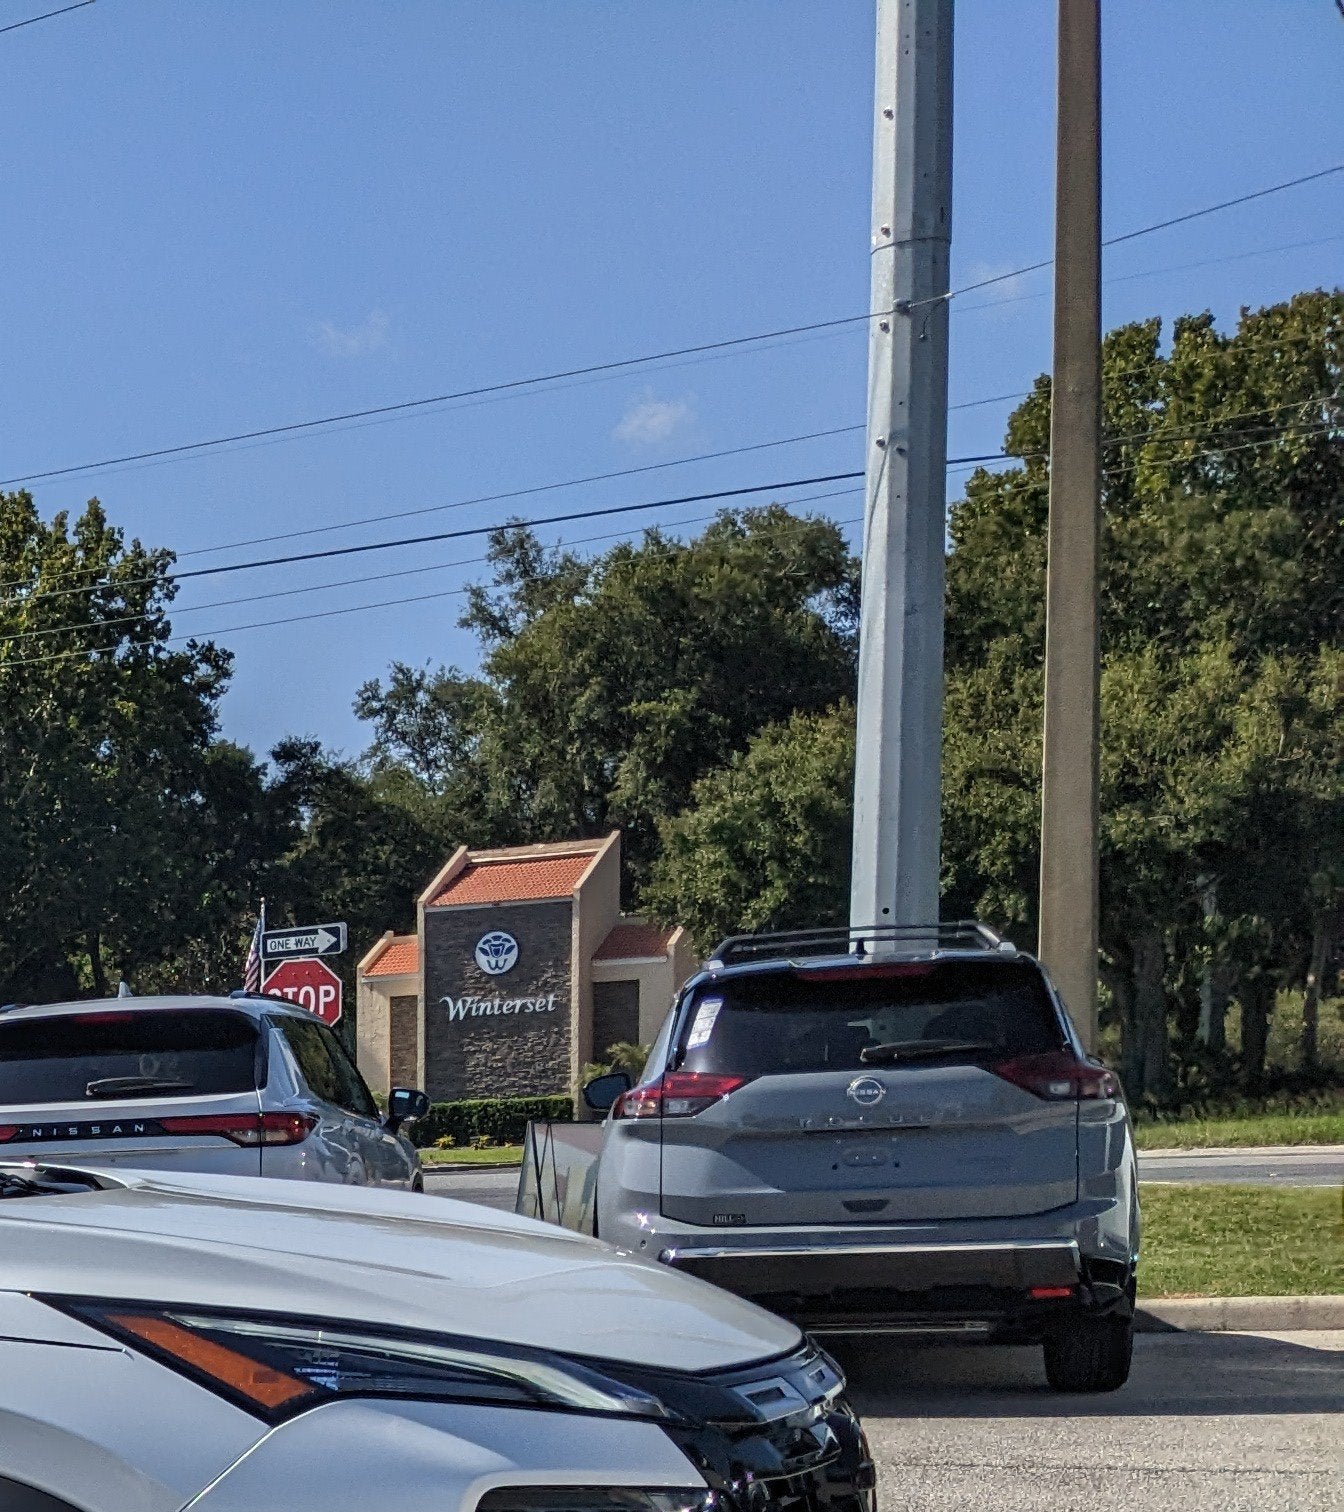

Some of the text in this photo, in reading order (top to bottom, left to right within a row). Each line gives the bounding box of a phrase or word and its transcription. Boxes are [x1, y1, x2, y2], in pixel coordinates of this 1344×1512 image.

[269, 936, 317, 951] ONE WAY
[268, 985, 336, 1015] TOP
[439, 993, 557, 1021] Winterset
[32, 1124, 144, 1137] NISSAN
